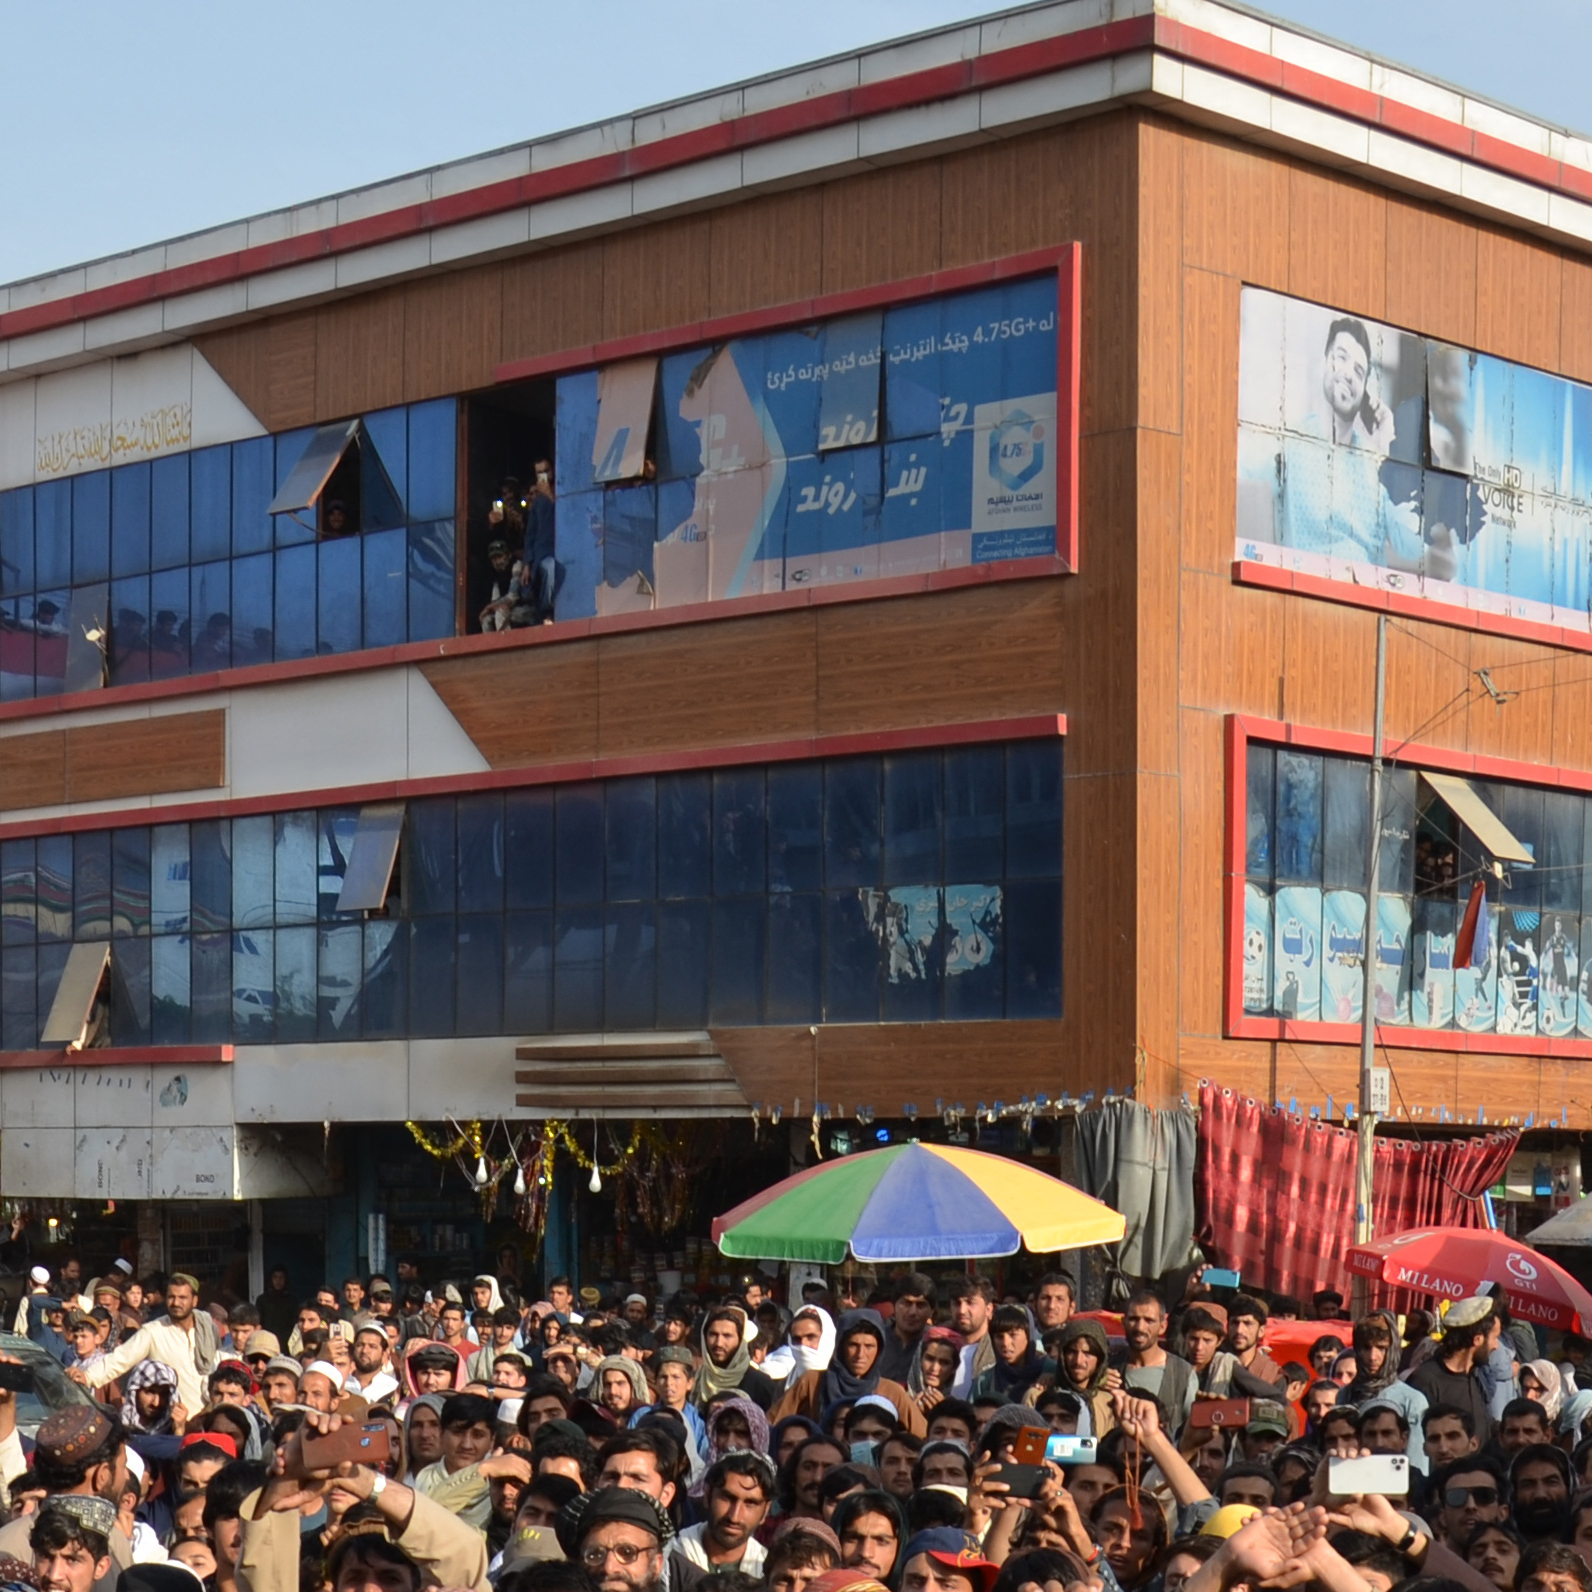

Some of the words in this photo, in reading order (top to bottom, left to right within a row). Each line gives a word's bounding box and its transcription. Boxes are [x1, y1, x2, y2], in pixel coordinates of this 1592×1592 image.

[973, 318, 1036, 344] 4.75G+
[1504, 465, 1521, 489] HD
[1482, 485, 1524, 513] VOICE
[1514, 1277, 1537, 1291] GTI
